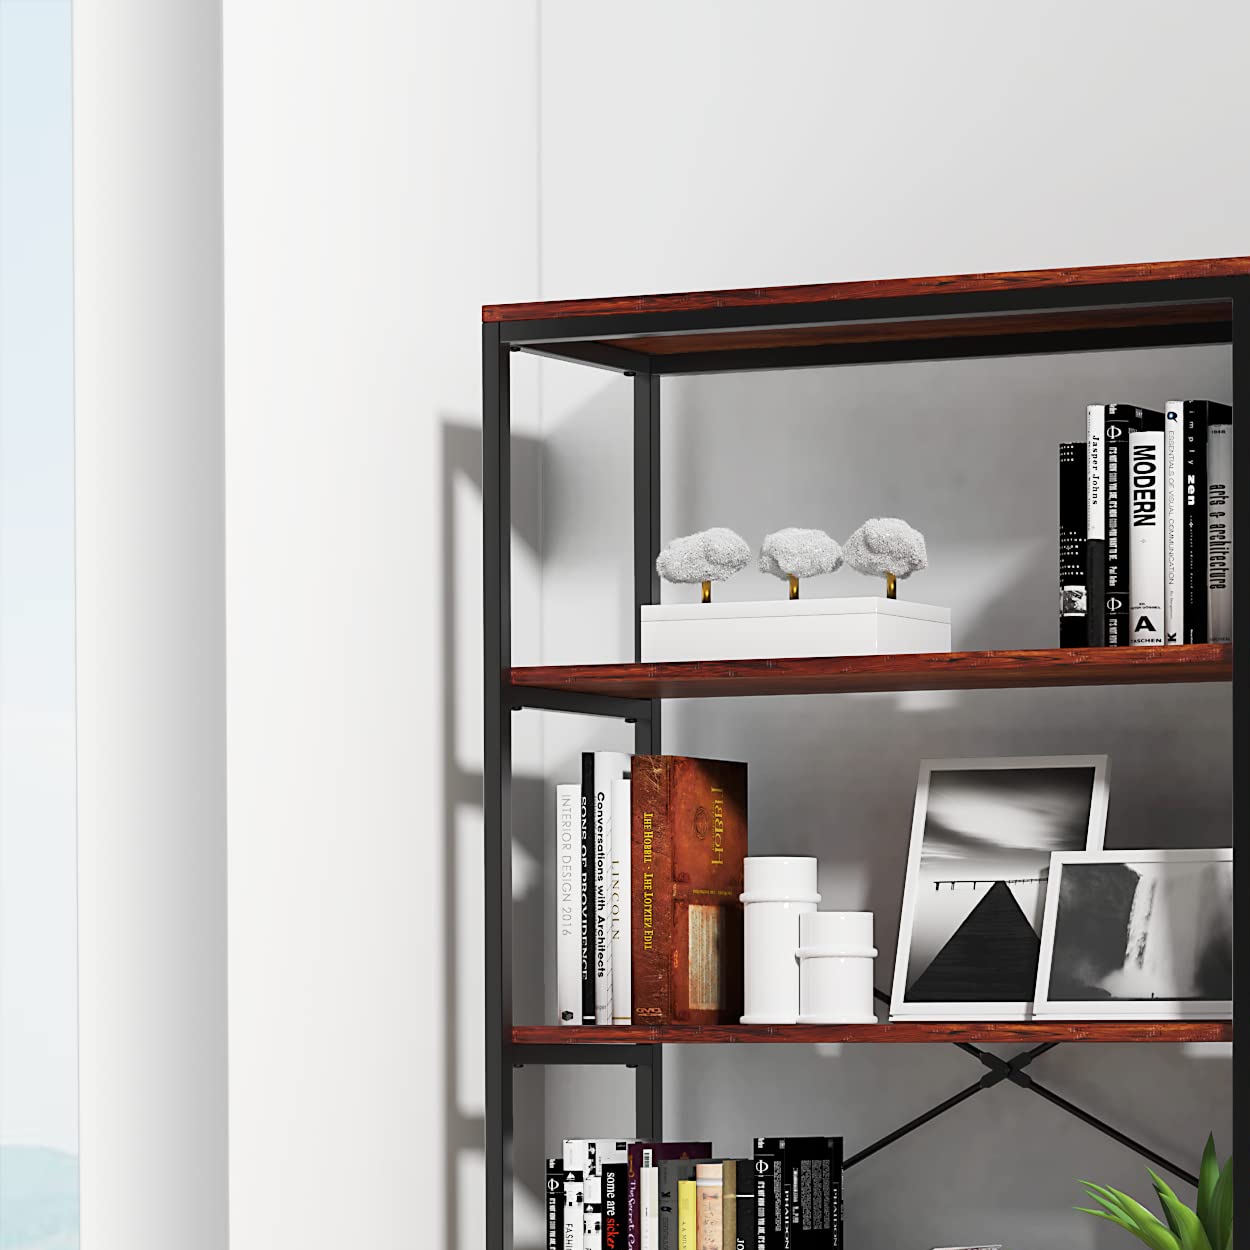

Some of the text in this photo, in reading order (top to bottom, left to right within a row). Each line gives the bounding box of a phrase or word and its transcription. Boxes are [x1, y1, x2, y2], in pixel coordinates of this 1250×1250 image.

[1091, 435, 1100, 505] Jasper Johns
[1133, 445, 1156, 528] MODERN
[1187, 474, 1195, 506] zen
[1209, 484, 1228, 506] arts
[1209, 523, 1231, 589] architecture
[1135, 616, 1155, 632] A
[561, 795, 572, 936] INTERIOR DESIGN 2016
[596, 792, 605, 977] Conversations with Architects
[611, 861, 620, 940] LINCOLN
[606, 1172, 616, 1199] some
[606, 1200, 616, 1216] are
[606, 1217, 620, 1249] sicker
